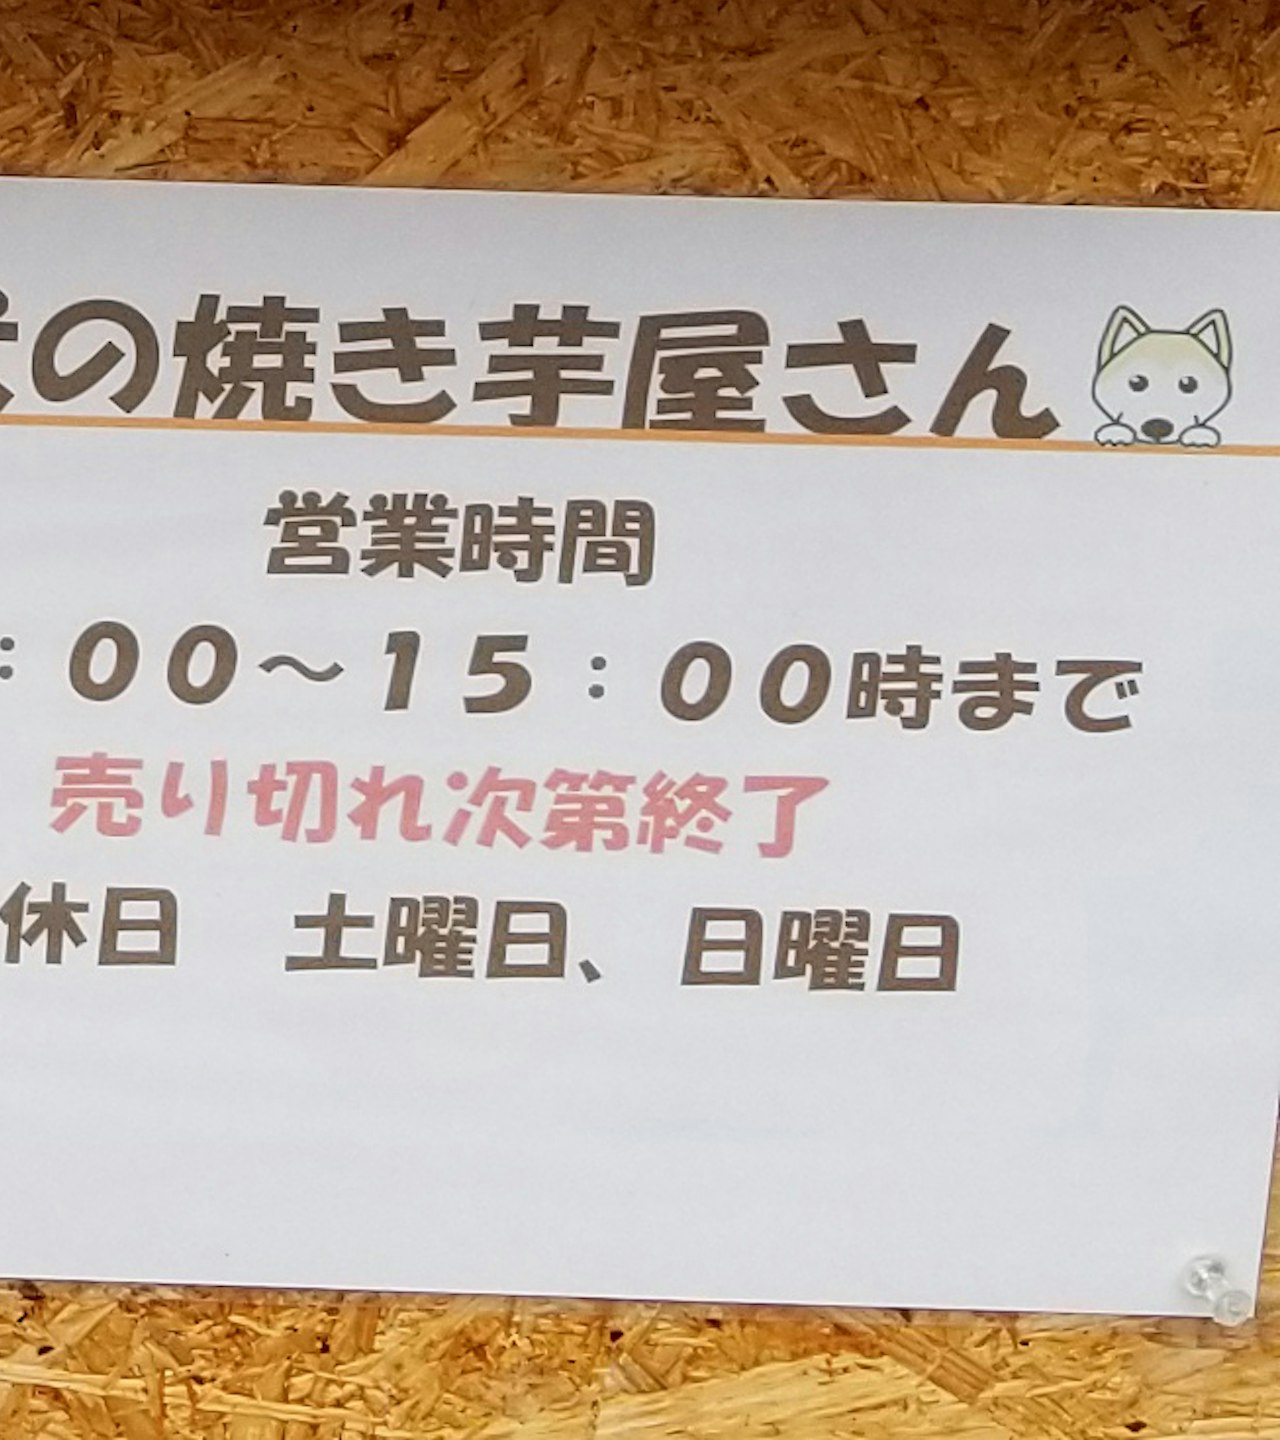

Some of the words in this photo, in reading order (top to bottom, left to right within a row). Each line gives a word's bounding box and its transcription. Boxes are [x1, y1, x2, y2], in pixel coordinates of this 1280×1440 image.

[262, 488, 658, 589] 営業時間
[51, 754, 830, 860] 売り切れ次第終了
